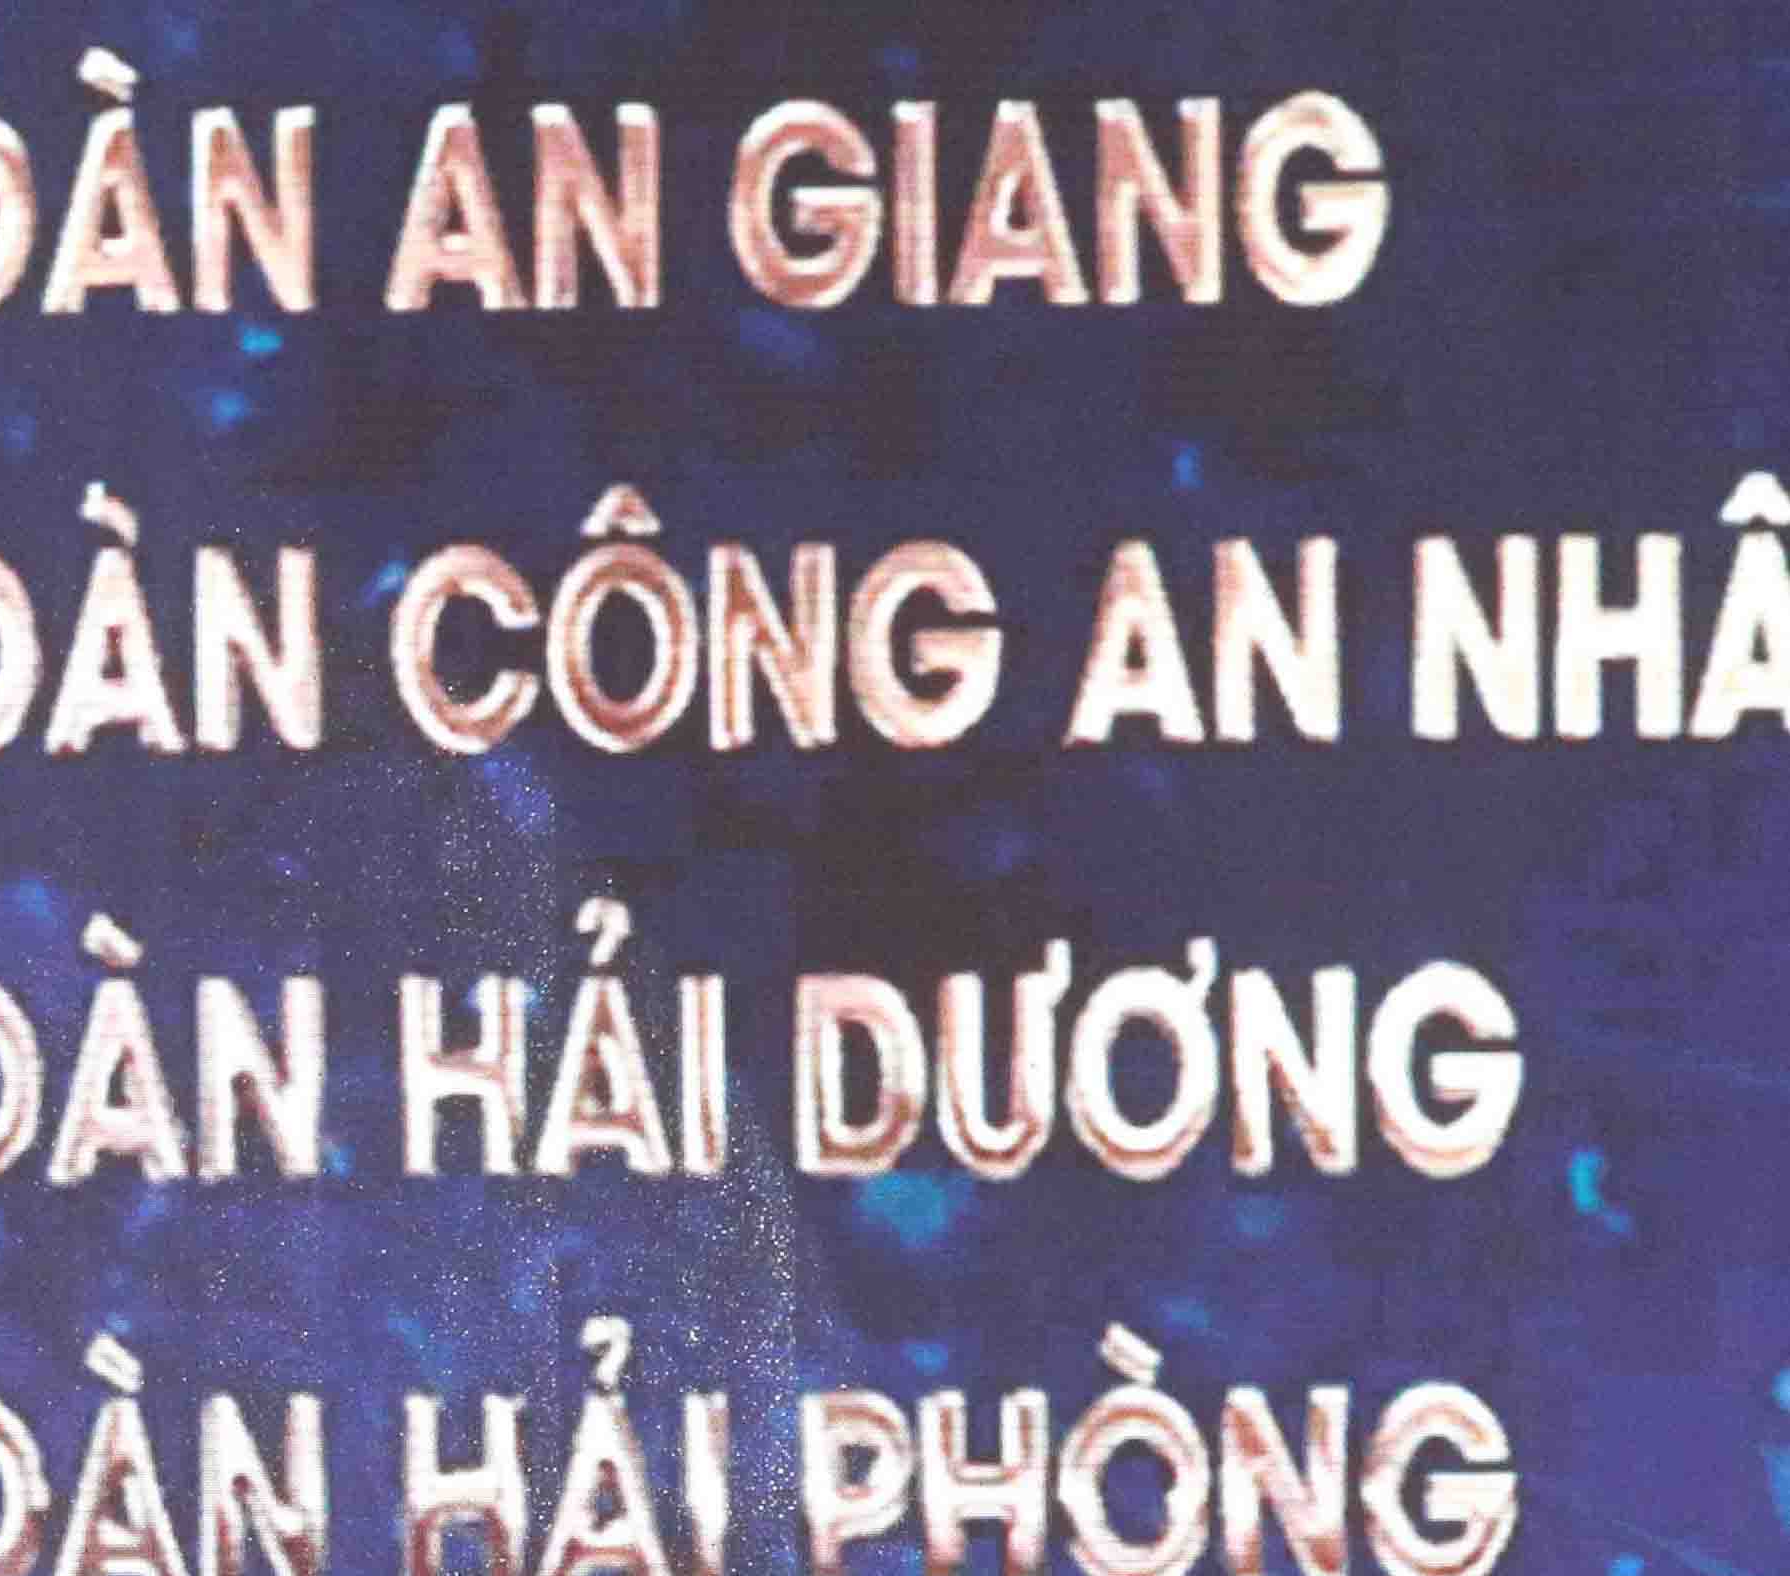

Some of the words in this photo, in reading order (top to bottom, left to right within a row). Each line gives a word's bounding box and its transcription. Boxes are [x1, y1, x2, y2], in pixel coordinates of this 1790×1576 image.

[386, 102, 662, 312] AN
[731, 88, 1389, 312] GIANG
[390, 483, 1004, 756] CÔNG
[1060, 541, 1342, 743] AN
[401, 897, 729, 1180] HẢI
[796, 938, 1525, 1180] DƯƠNG
